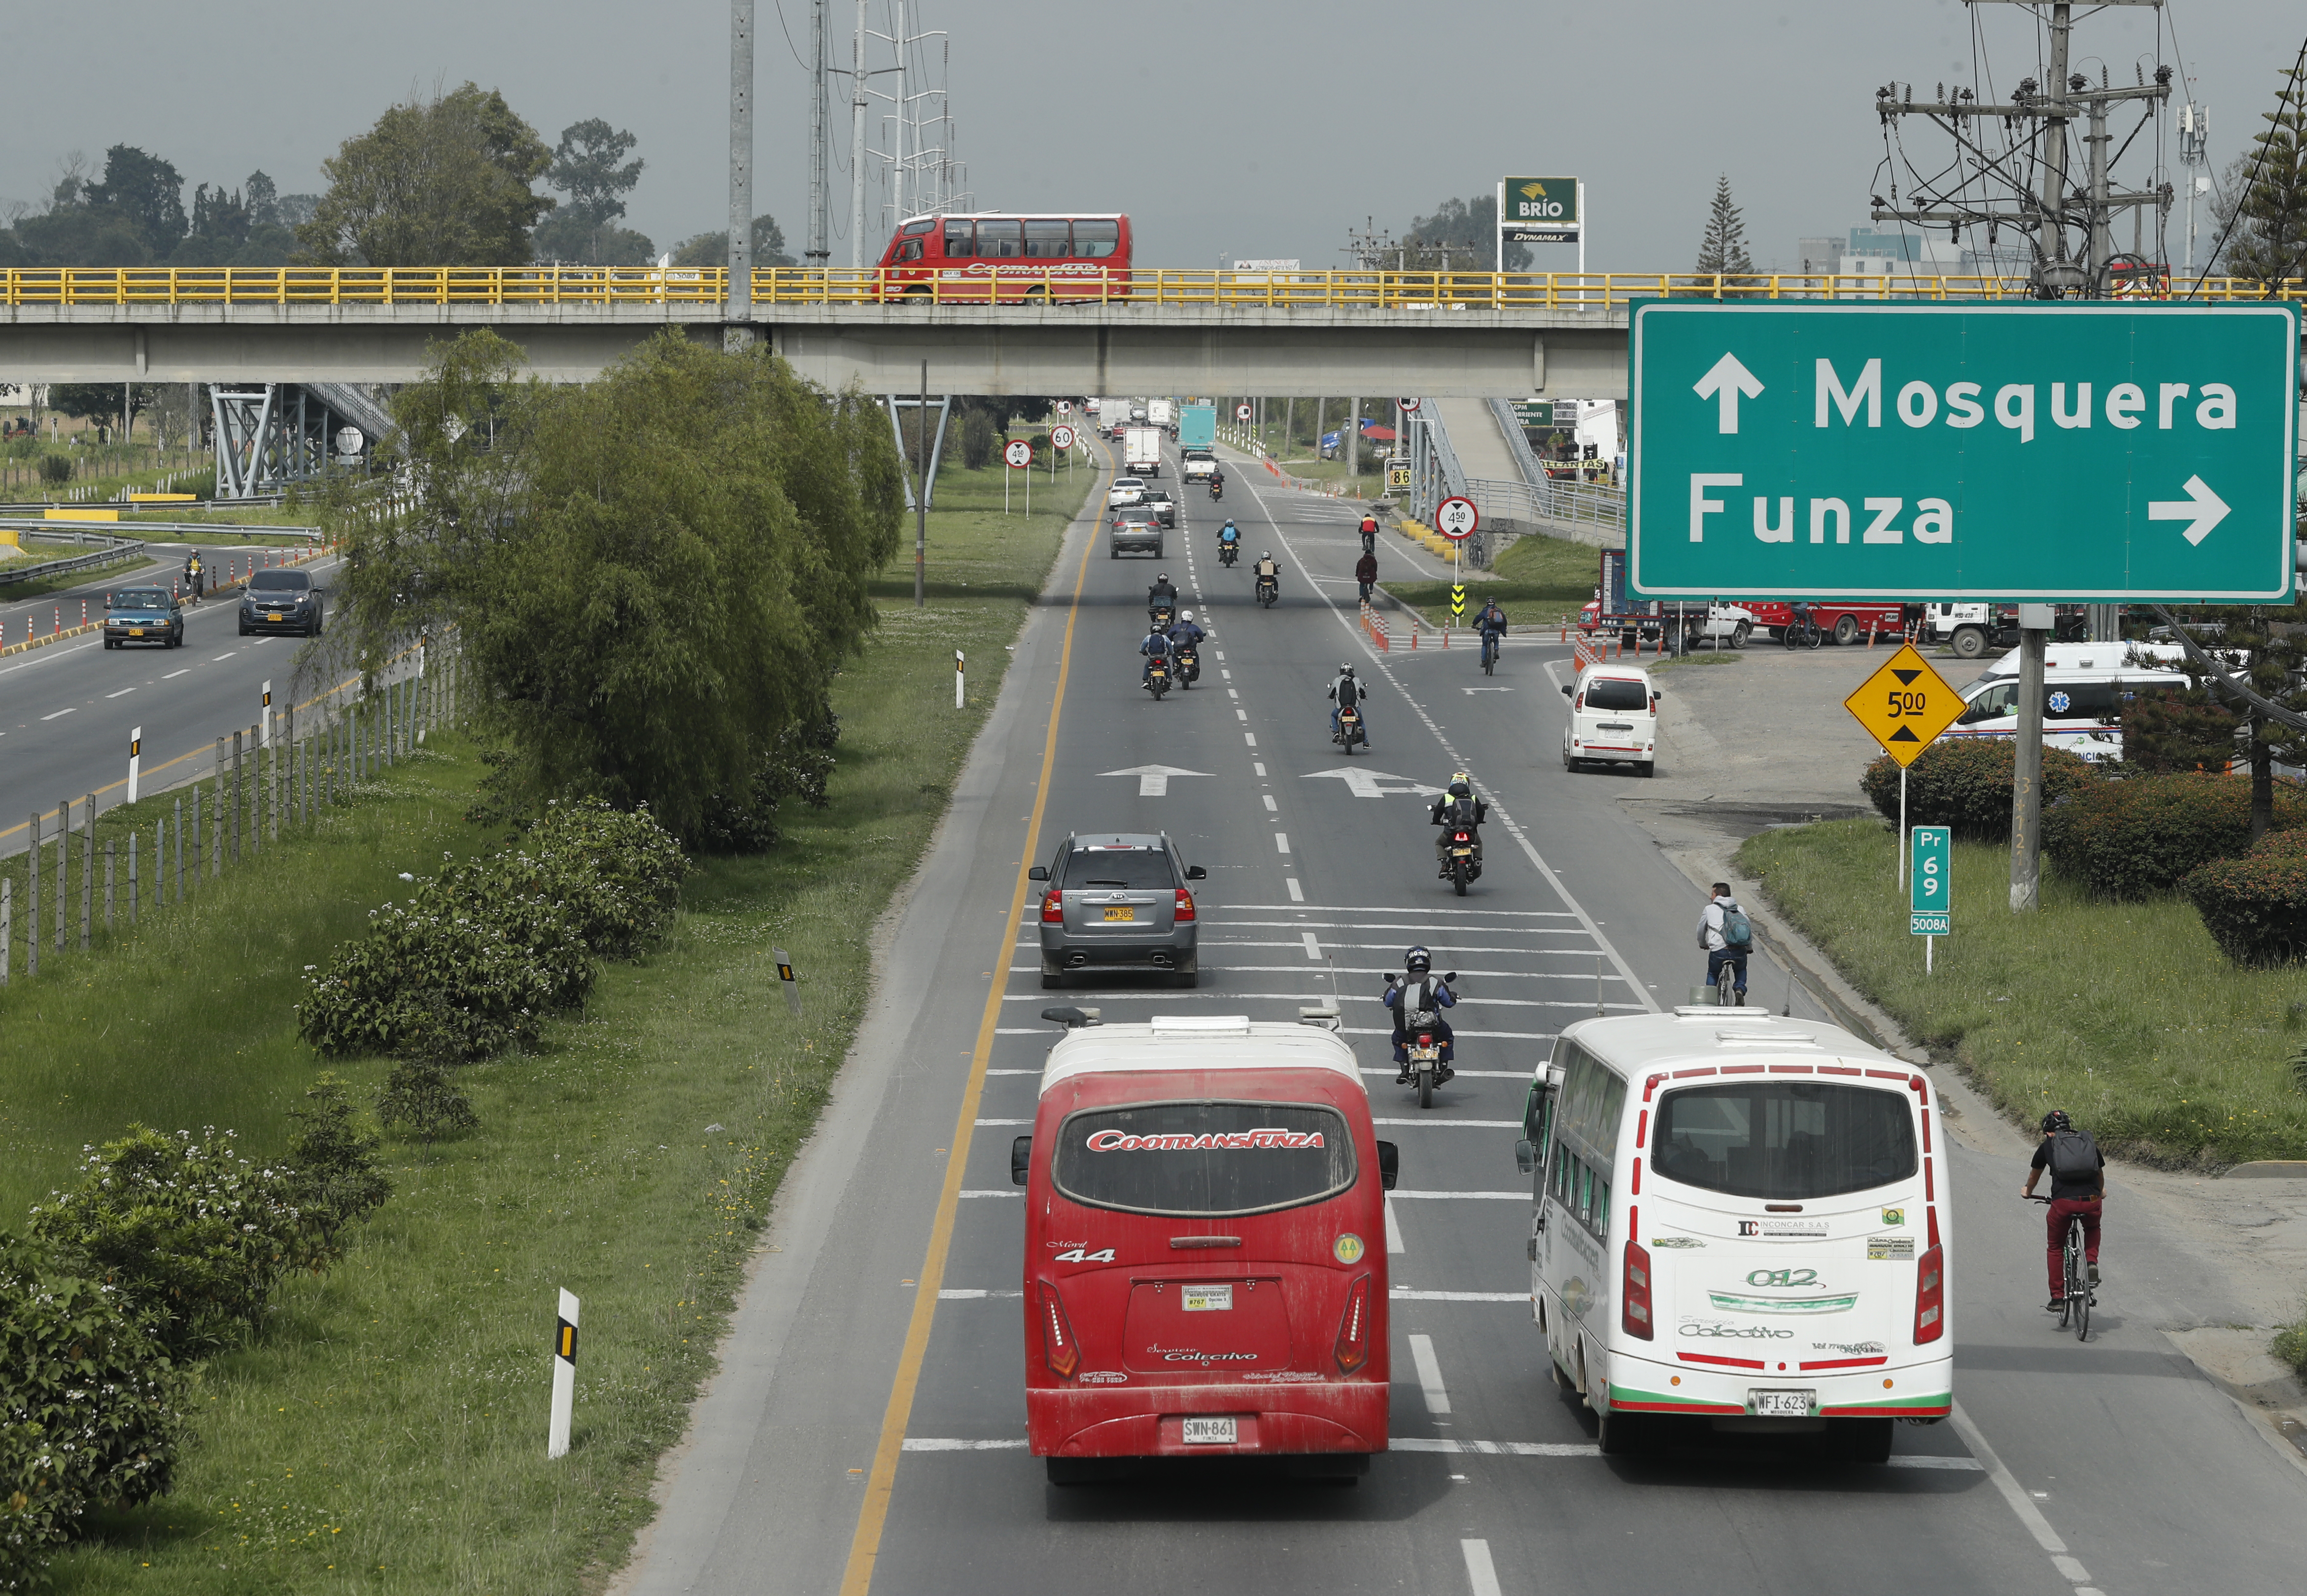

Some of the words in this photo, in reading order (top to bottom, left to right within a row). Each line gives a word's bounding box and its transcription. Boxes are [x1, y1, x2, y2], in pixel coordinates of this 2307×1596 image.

[1519, 198, 1563, 217] BRÍO
[1816, 358, 2236, 443] Mosquera
[1055, 432, 1070, 442] 60
[1690, 474, 1952, 544] Funza
[1887, 692, 1926, 718] 500
[1921, 832, 1941, 847] Pr
[1913, 918, 1947, 930] 5008A
[1054, 1248, 1115, 1262] 44
